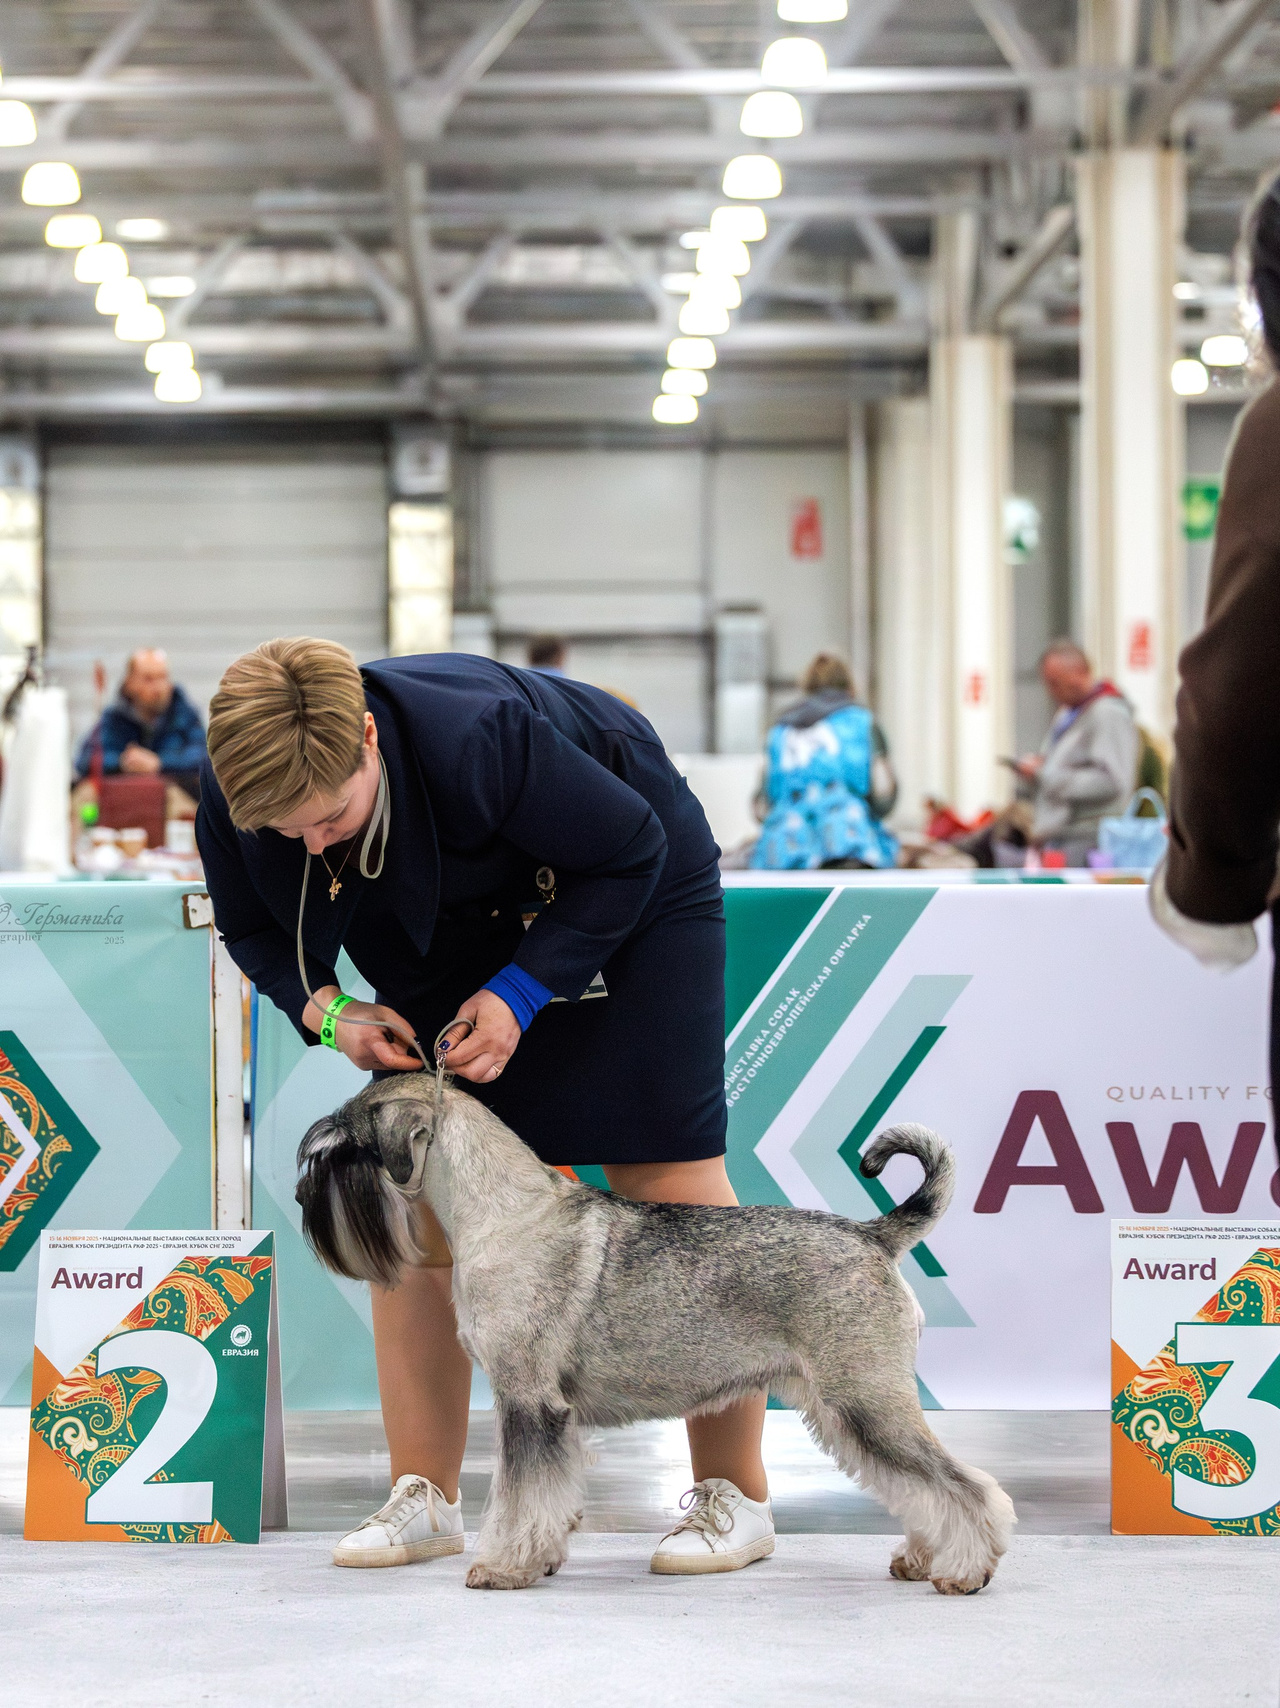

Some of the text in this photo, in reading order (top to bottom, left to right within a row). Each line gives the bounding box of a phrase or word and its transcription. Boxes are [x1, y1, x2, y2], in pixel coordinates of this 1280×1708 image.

[726, 914, 872, 1108] ВОСТОЧНОЕВРОПЕЙСКАЯ ОВЧАРКА
[768, 987, 801, 1028] СОБАК
[1106, 1086, 1230, 1102] QUALITY
[51, 1266, 143, 1289] Award
[1123, 1258, 1217, 1280] Award
[222, 1349, 259, 1357] ЕВРАЗИЯ
[86, 1330, 218, 1523] 2
[1174, 1324, 1280, 1520] 3
